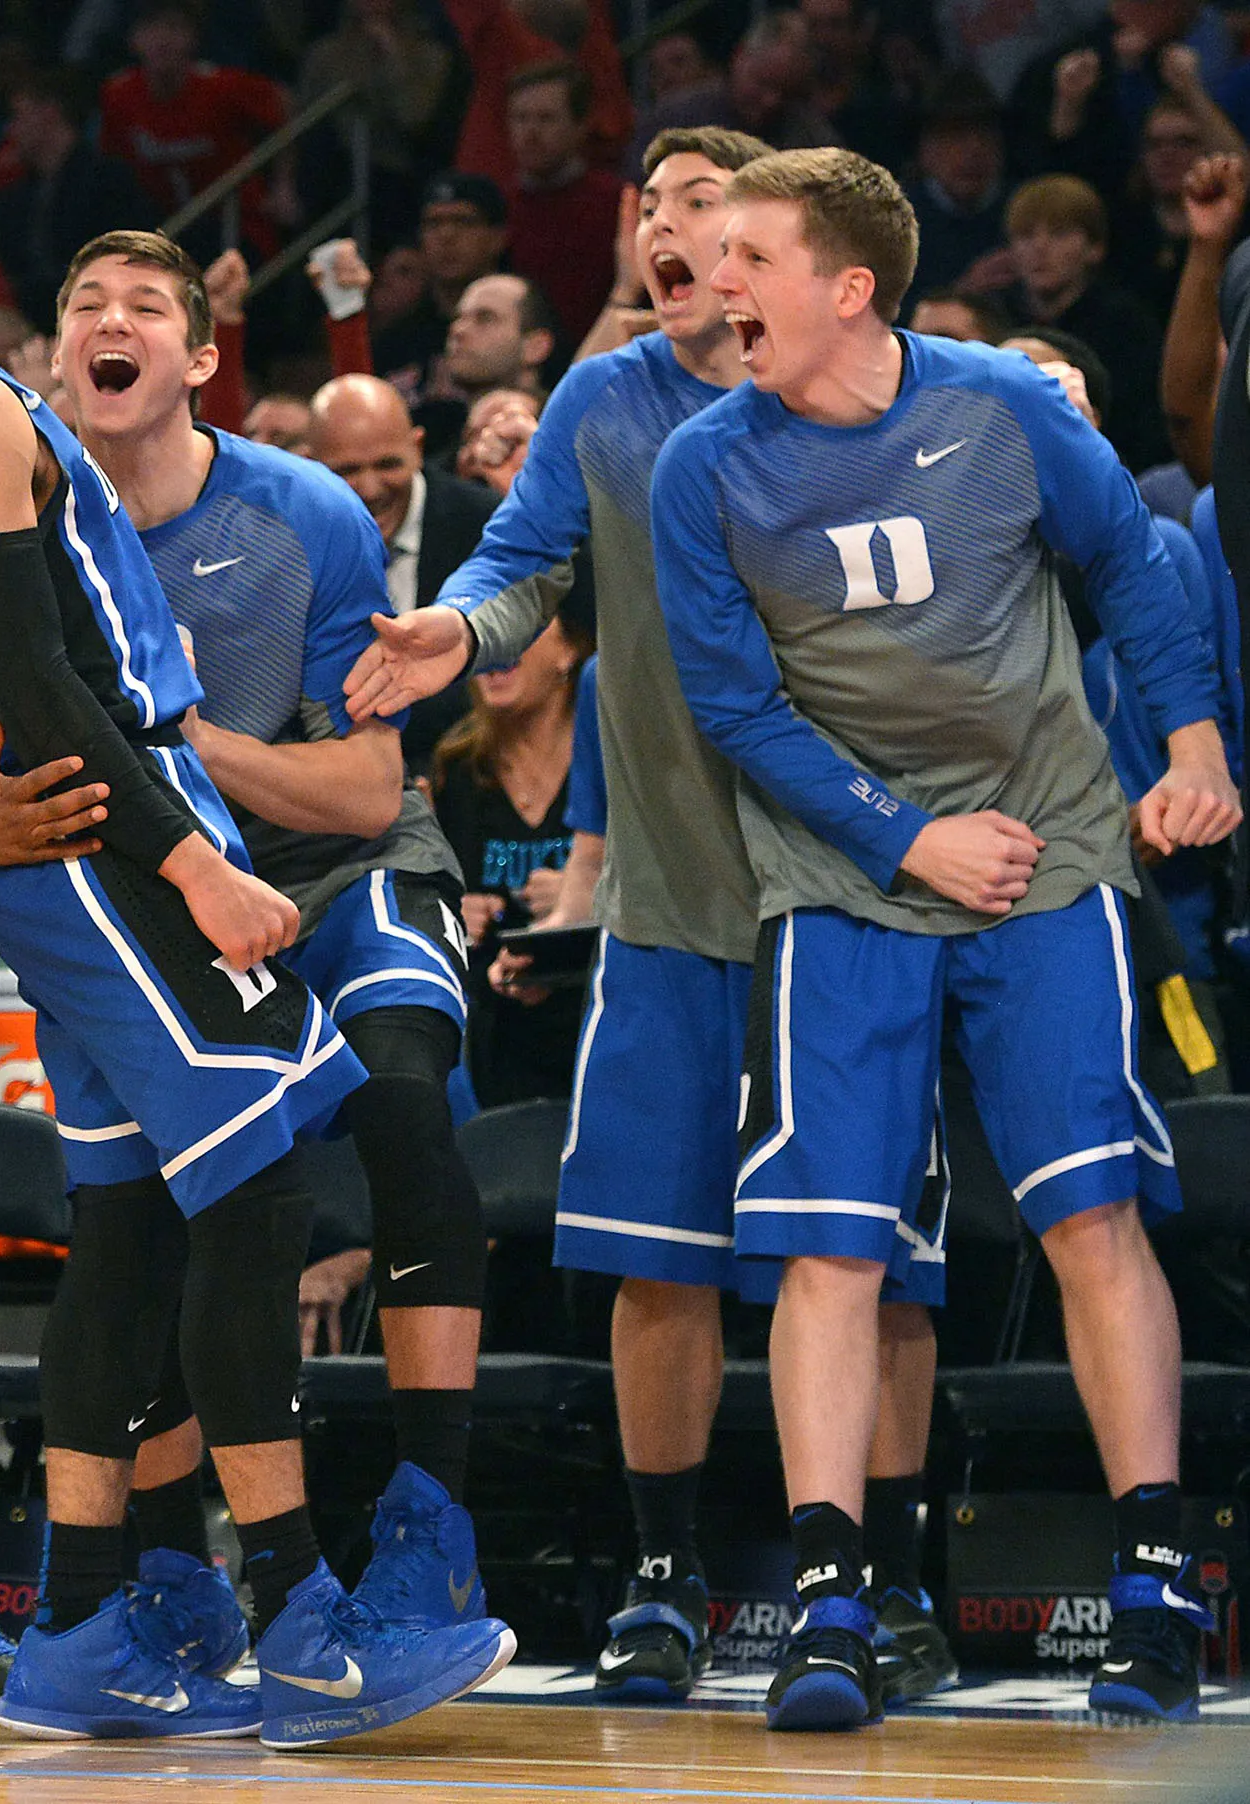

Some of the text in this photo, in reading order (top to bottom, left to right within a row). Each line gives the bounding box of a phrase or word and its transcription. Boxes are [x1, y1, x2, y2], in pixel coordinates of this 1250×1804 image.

[824, 515, 936, 612] D
[482, 837, 574, 889] DUK
[1034, 1634, 1111, 1664] Super
